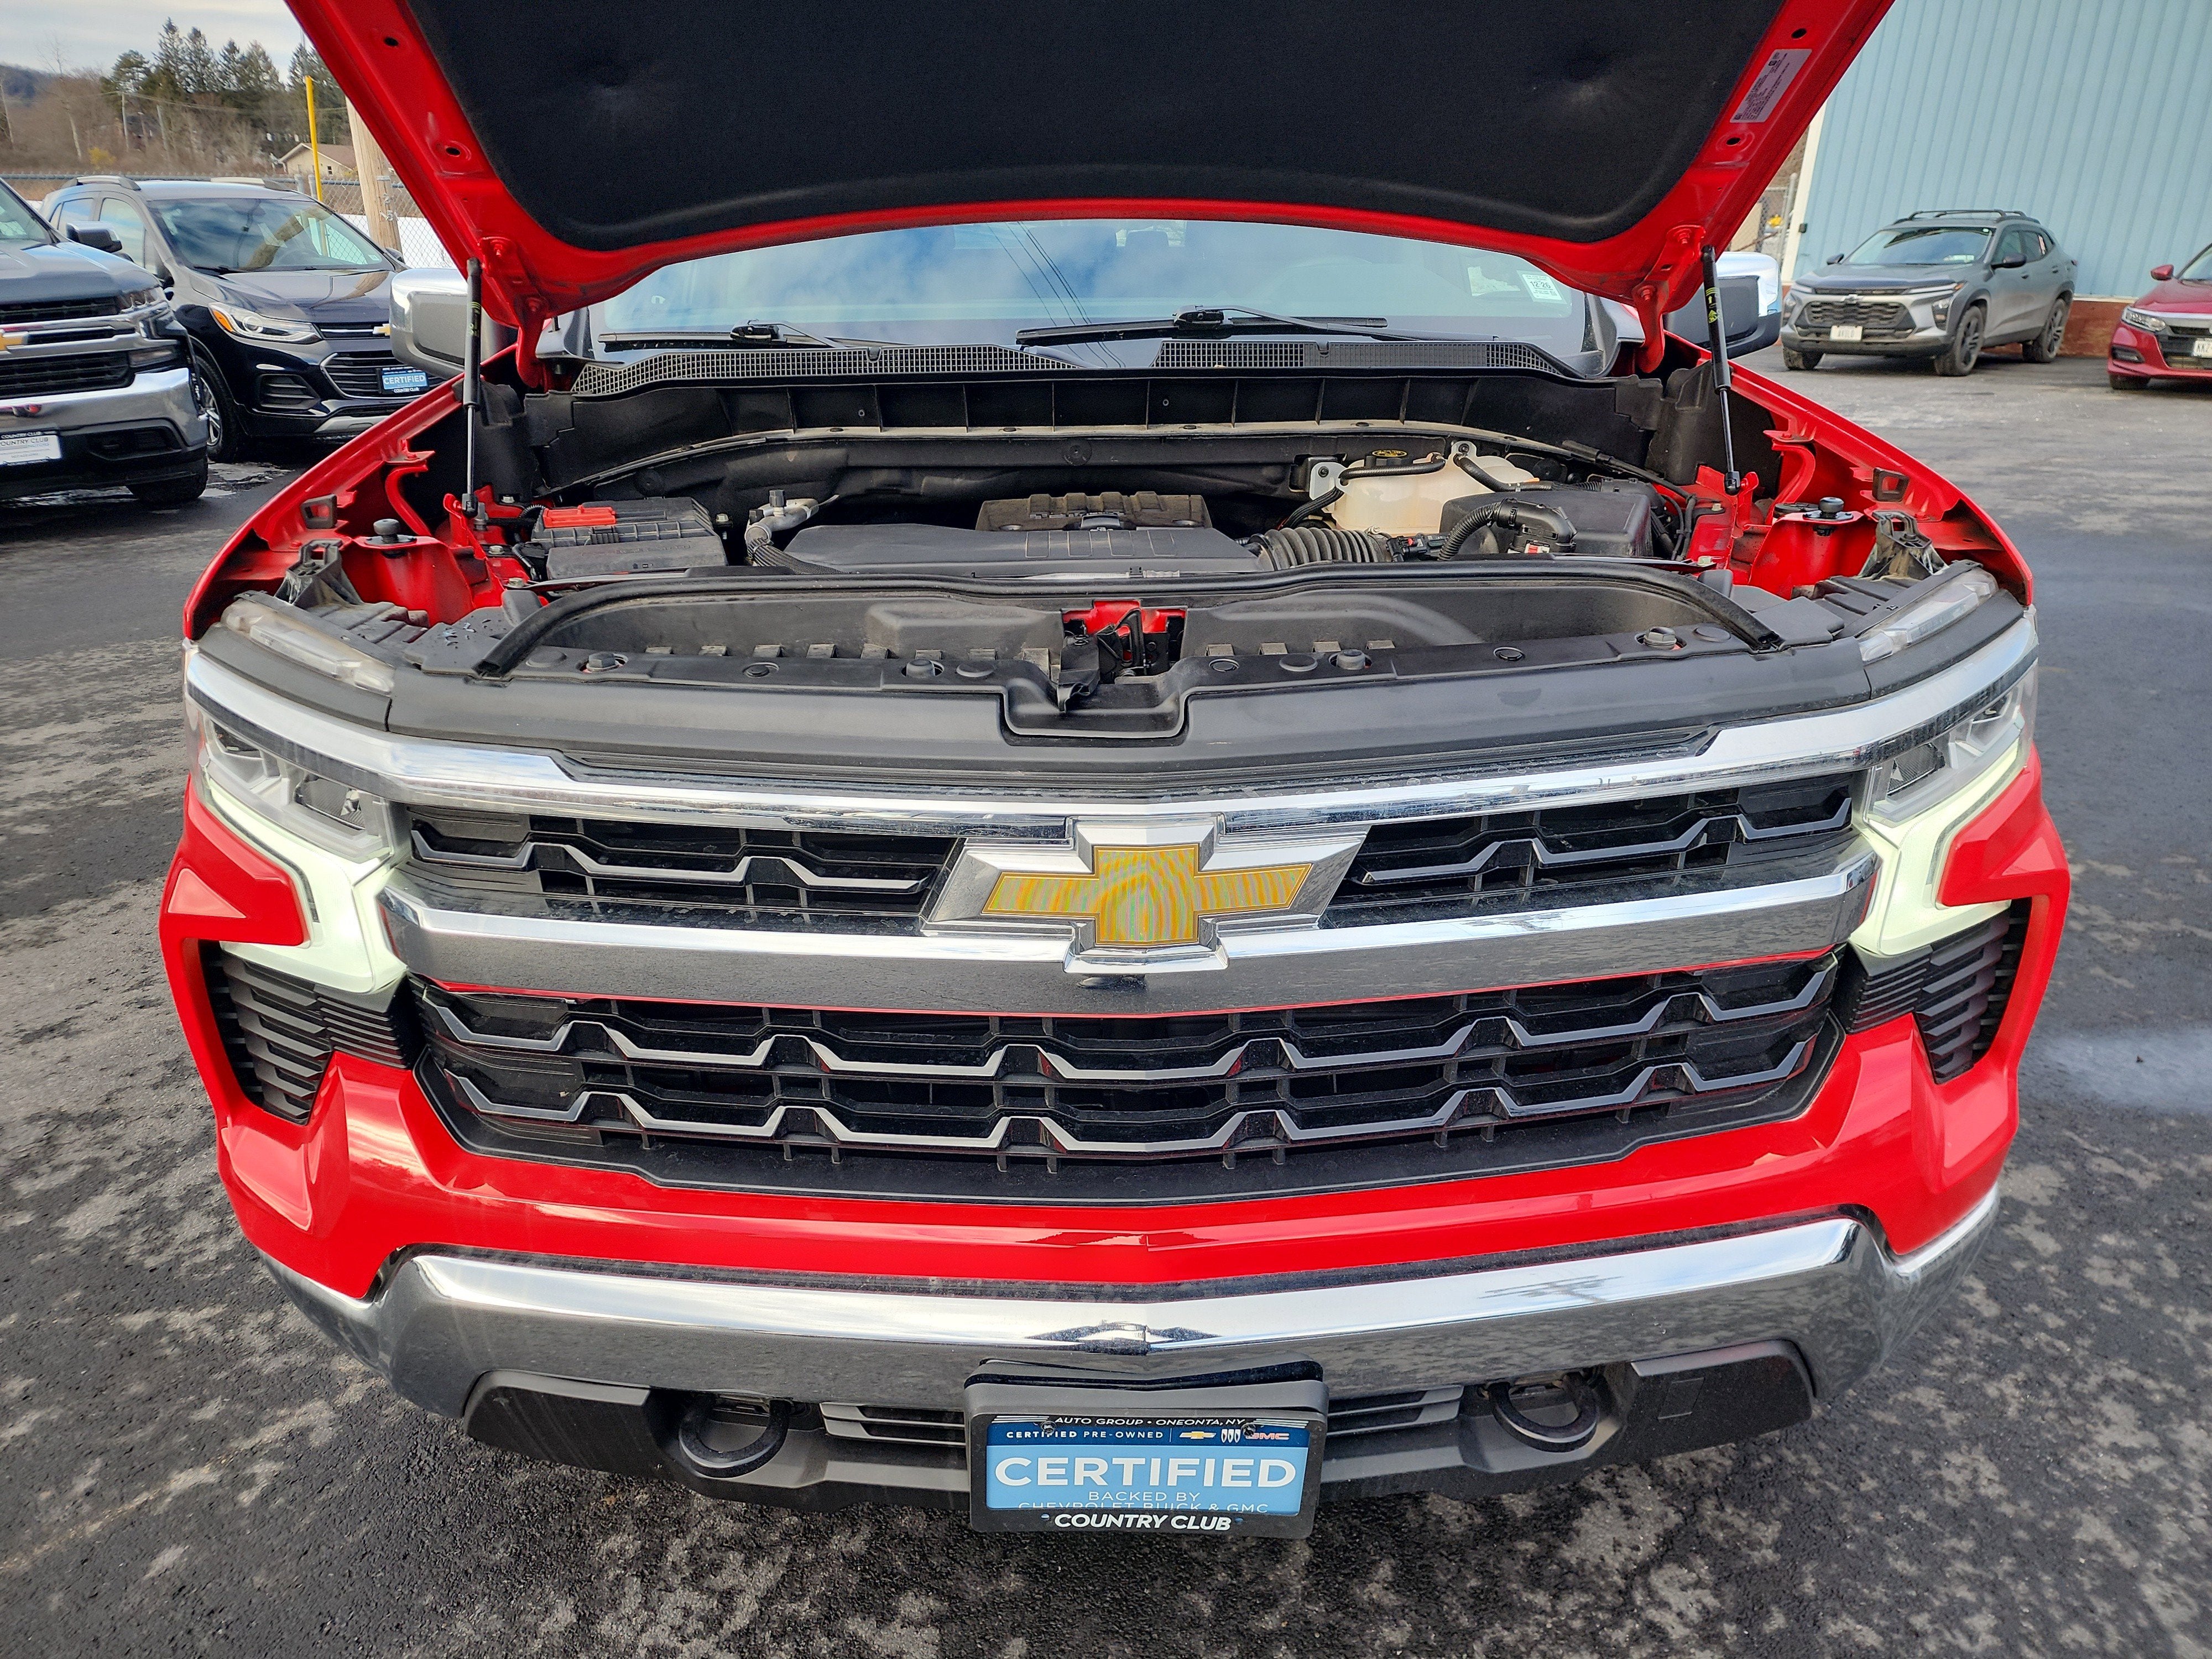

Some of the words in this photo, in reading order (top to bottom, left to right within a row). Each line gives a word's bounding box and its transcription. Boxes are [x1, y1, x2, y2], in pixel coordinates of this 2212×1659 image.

[383, 375, 425, 385] CERTIFIED
[995, 1457, 1297, 1488] CERTIFIED
[1088, 1491, 1167, 1501] BACKED
[1176, 1492, 1201, 1502] BY
[1208, 1503, 1219, 1511] &
[1227, 1503, 1269, 1514] GMC
[1054, 1514, 1169, 1529] COUNTRY
[1170, 1515, 1232, 1531] CLUB
